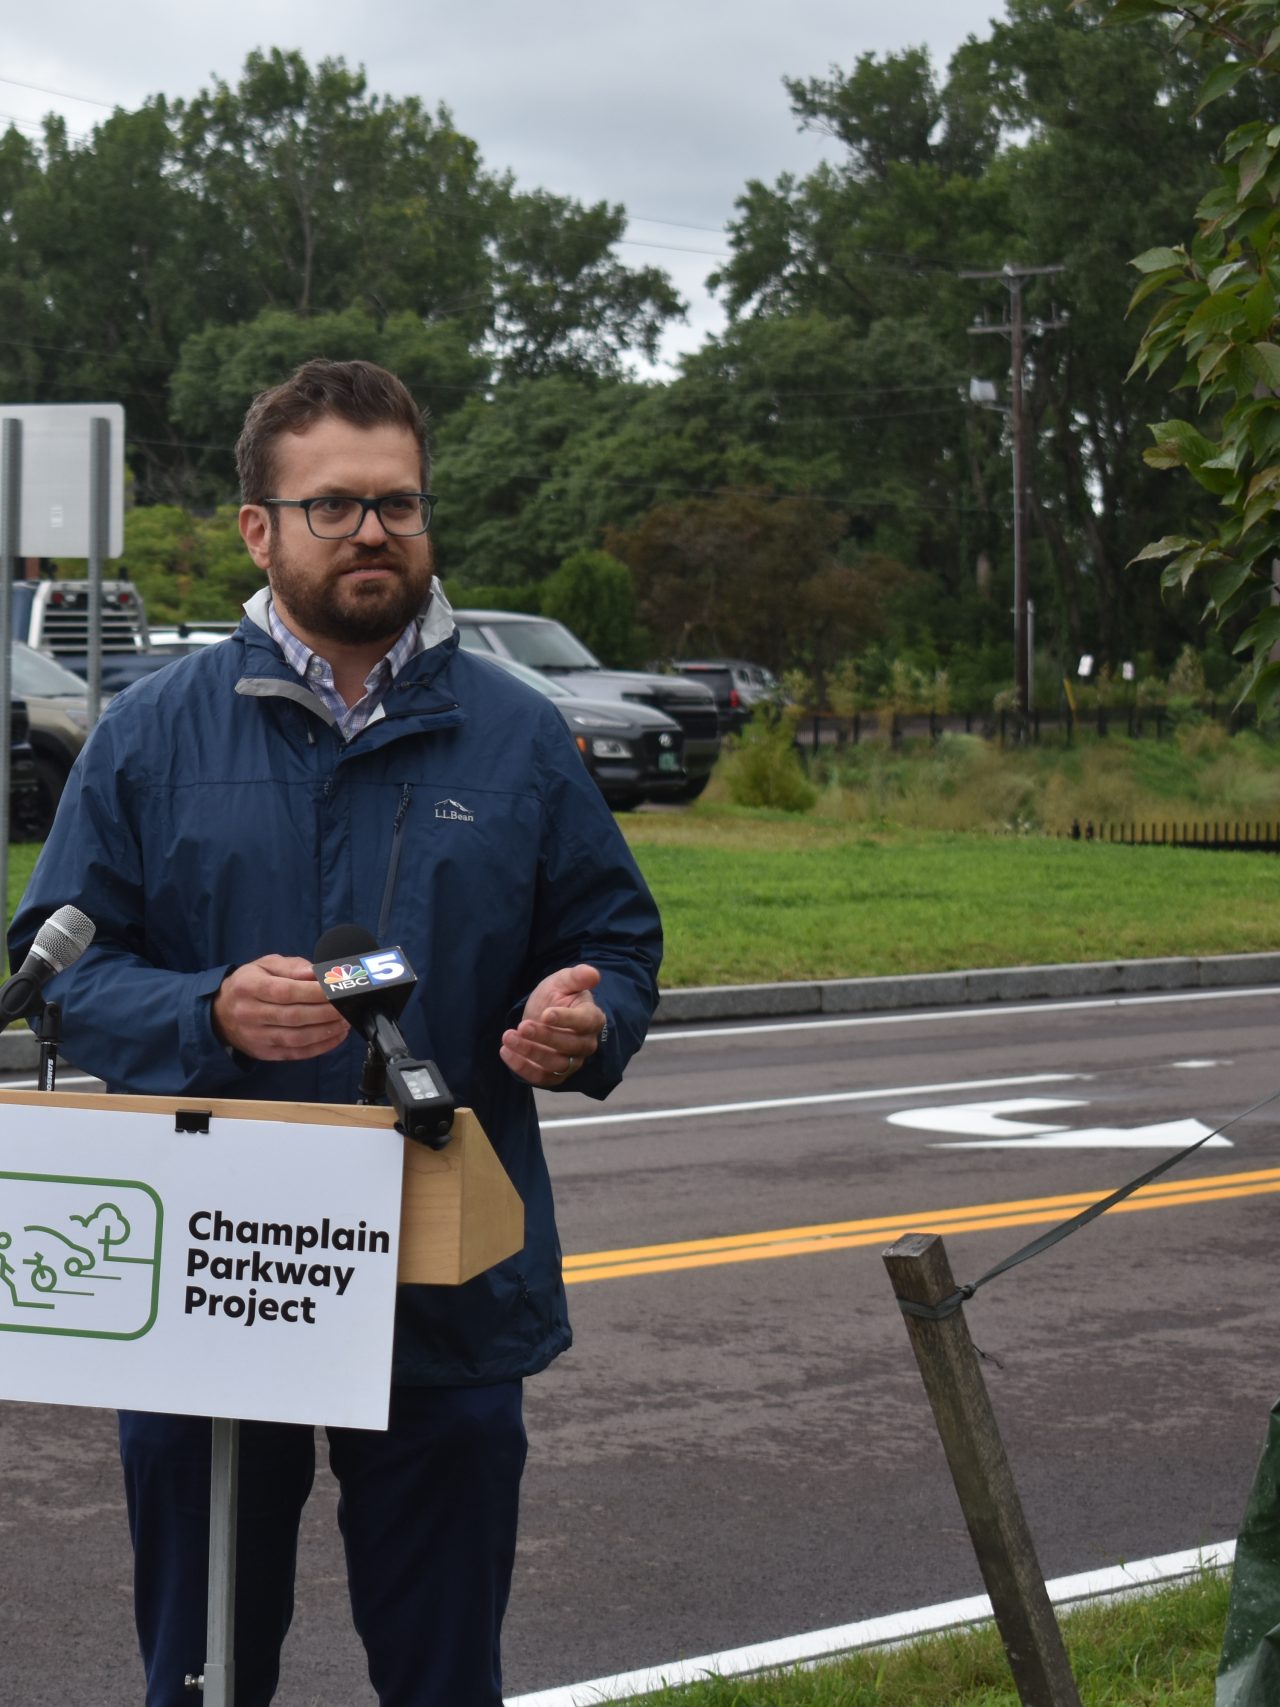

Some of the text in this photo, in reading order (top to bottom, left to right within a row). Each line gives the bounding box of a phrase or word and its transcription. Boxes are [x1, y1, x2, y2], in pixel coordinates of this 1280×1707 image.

[330, 953, 405, 992] NBC 5
[188, 1210, 390, 1254] Champlain
[186, 1248, 355, 1296] Parkway
[184, 1285, 316, 1326] Project
